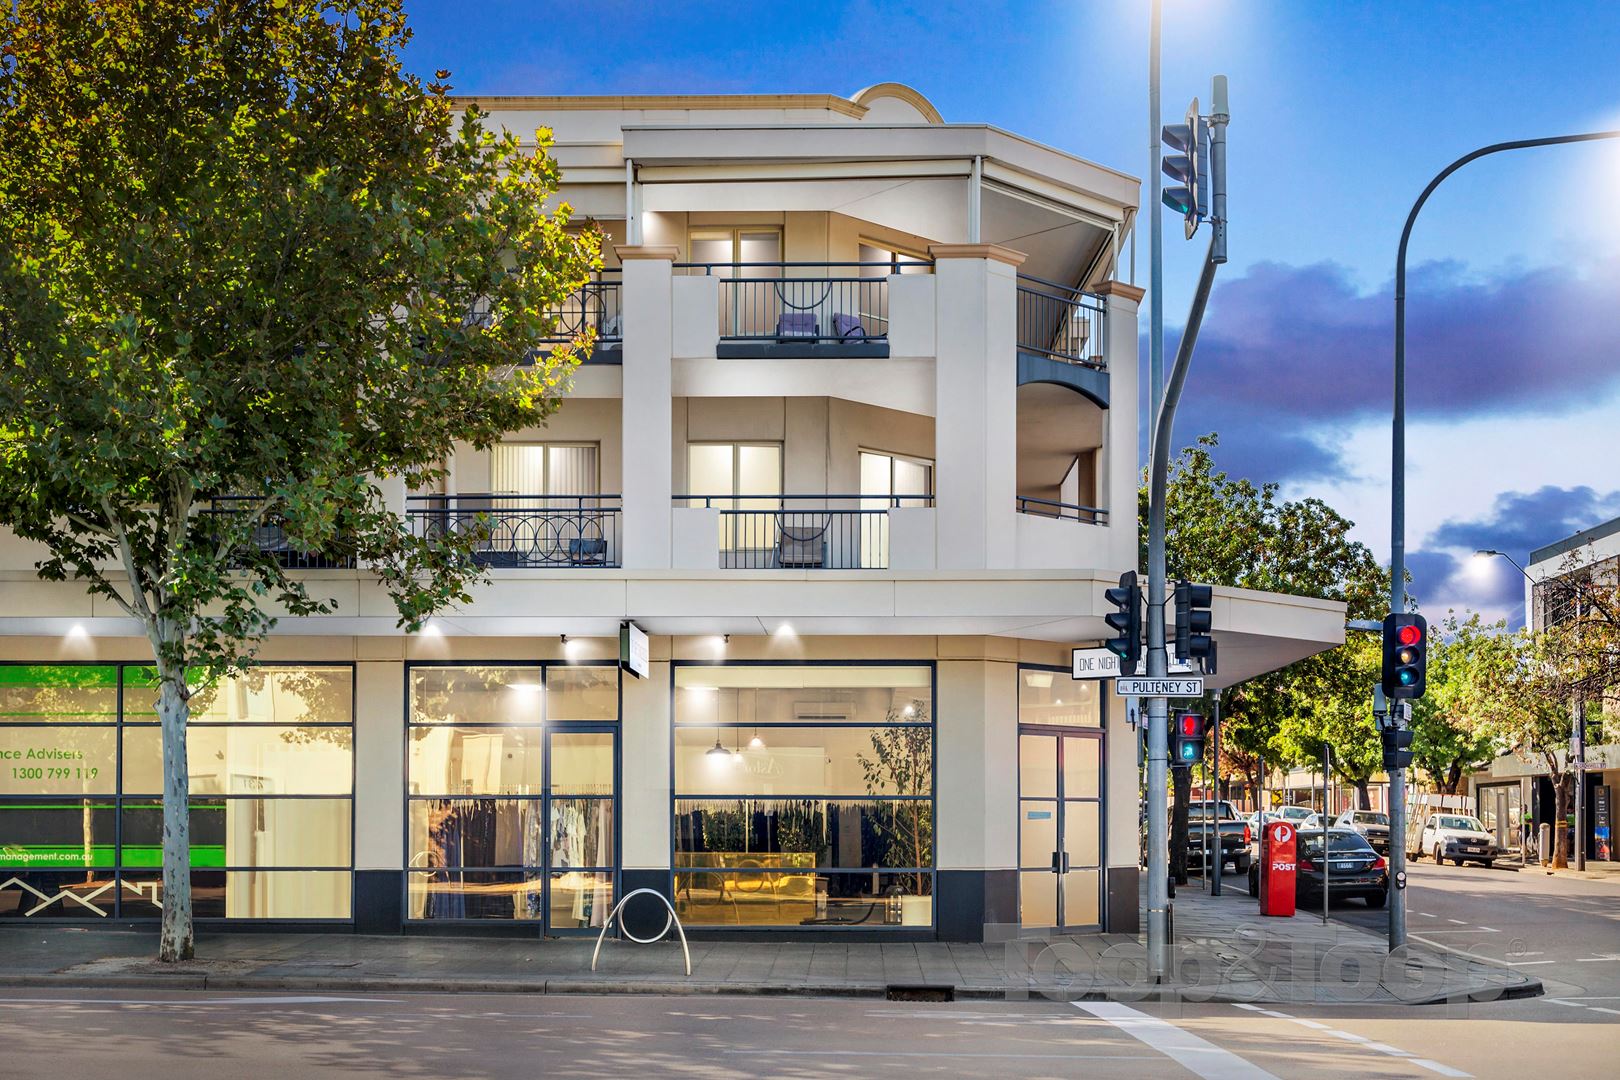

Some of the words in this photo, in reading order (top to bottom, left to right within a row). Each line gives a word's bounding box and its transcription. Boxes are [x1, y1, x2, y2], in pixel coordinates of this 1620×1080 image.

[1080, 658, 1094, 671] ONE
[1132, 682, 1181, 692] PULTENEY
[1186, 682, 1197, 692] ST
[26, 748, 83, 759] Advisers
[12, 767, 42, 779] 1300
[47, 767, 70, 779] 799
[76, 767, 98, 779] 119
[1272, 863, 1296, 871] POST
